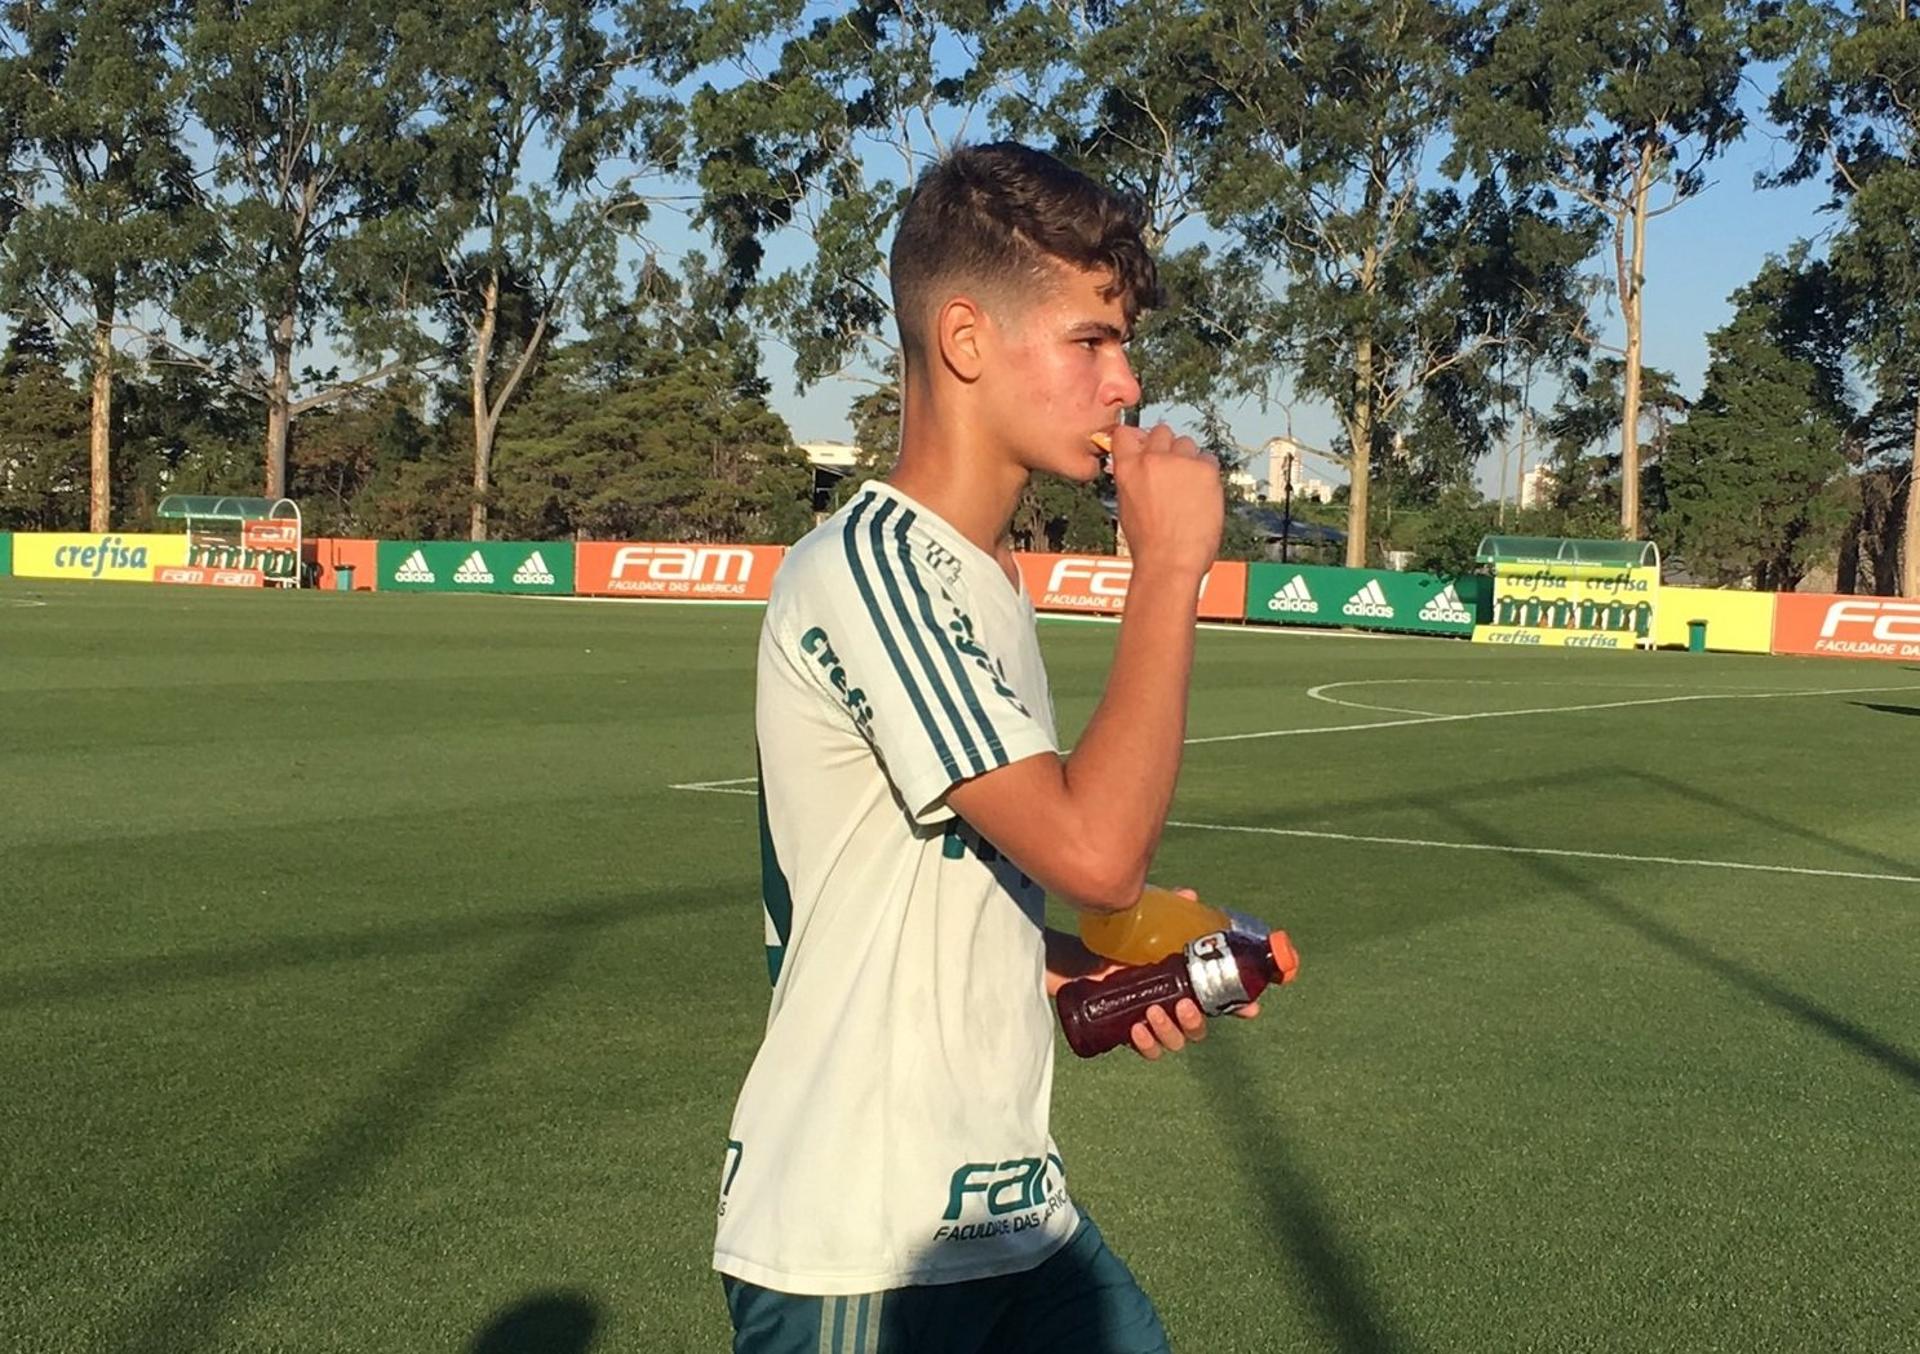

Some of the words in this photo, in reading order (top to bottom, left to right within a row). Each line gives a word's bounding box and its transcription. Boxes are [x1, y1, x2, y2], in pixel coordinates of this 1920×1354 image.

[55, 536, 147, 577] crefisa
[395, 571, 435, 584] adidas
[453, 572, 494, 585] adidas
[513, 573, 555, 586] adidas
[1506, 569, 1567, 592] crefisa
[1586, 571, 1648, 596] crefisa
[608, 581, 665, 592] FACULDADE
[1044, 594, 1107, 607] FACULDADE
[1268, 597, 1319, 613] adidas
[1342, 603, 1394, 619] adidas
[1418, 608, 1472, 624] adidas
[1488, 630, 1541, 644] crefisa
[1564, 633, 1618, 649] crefisa
[1815, 640, 1897, 655] FACULDADE
[1900, 644, 1920, 657] DA
[1014, 1212, 1040, 1233] DAS
